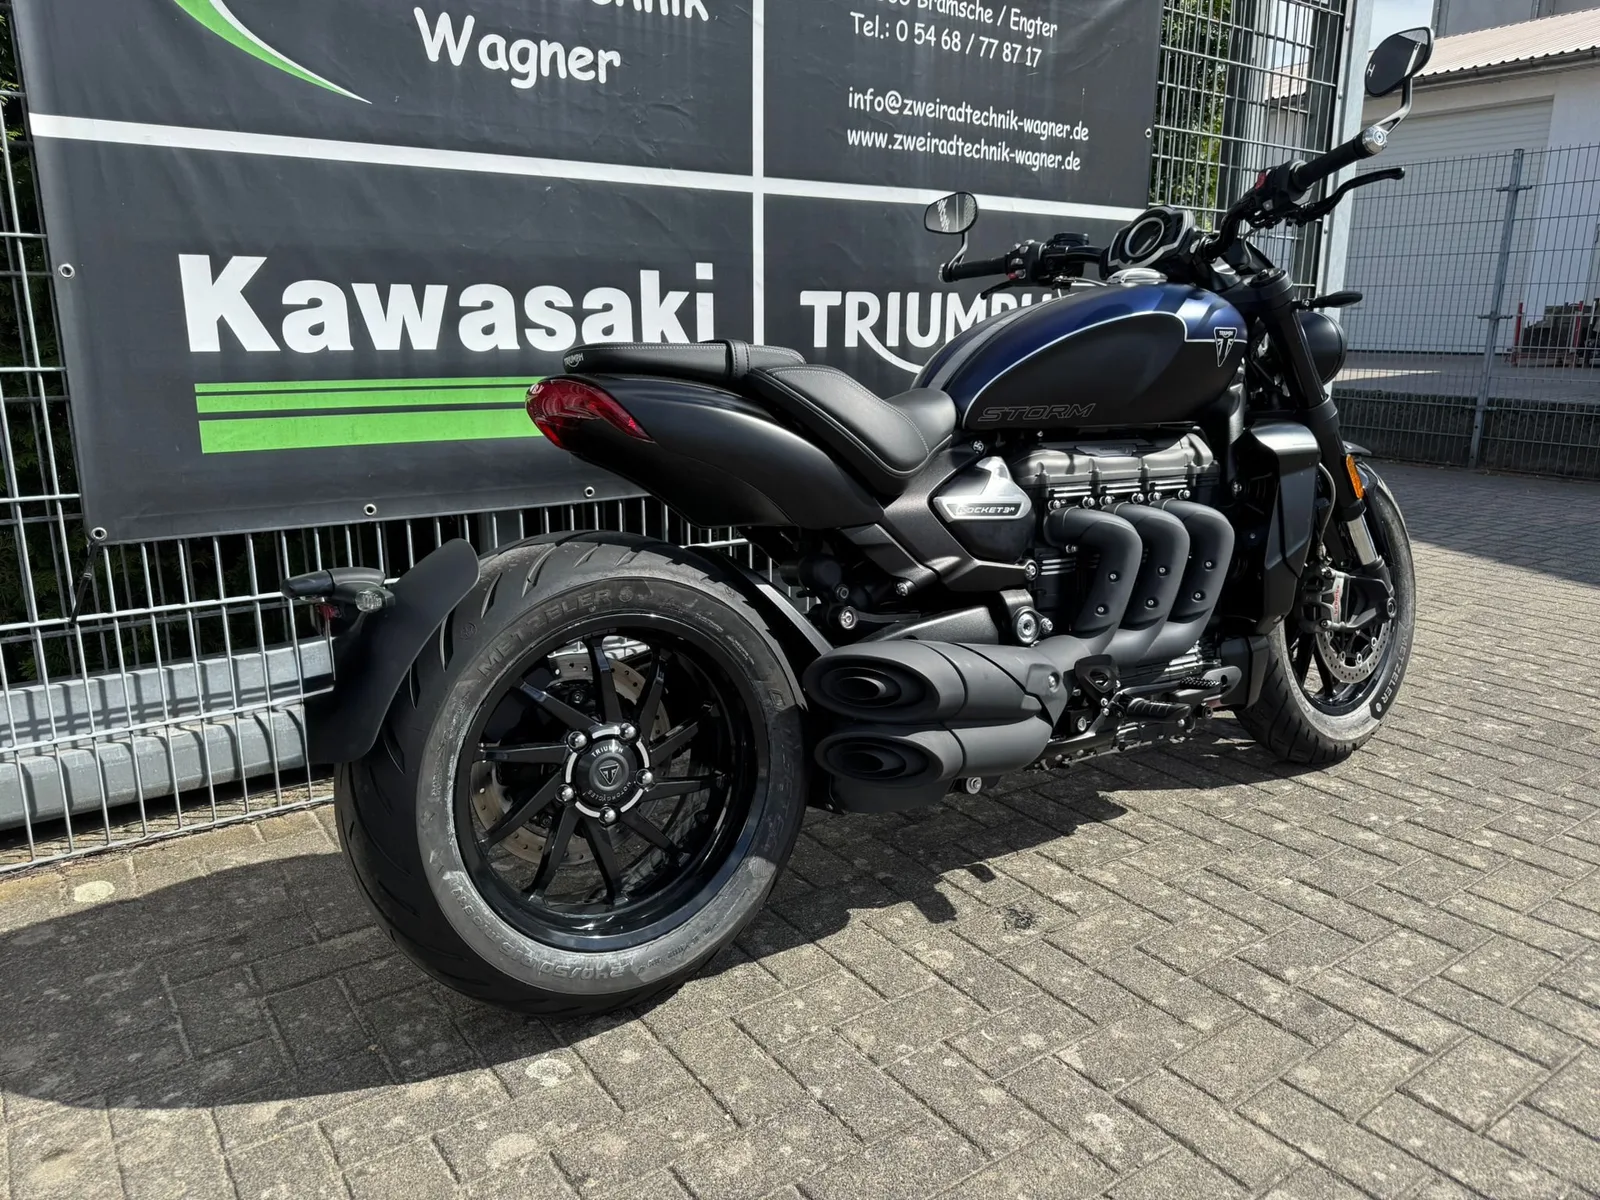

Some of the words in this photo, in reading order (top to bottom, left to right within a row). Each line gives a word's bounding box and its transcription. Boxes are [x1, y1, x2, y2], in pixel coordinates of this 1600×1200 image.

[413, 7, 621, 89] Wagner
[850, 12, 890, 39] Tel.:
[895, 20, 909, 42] 0
[913, 23, 937, 47] 54
[941, 28, 961, 52] 68
[965, 33, 975, 55] /
[978, 36, 999, 60] 77
[1002, 42, 1022, 64] 87
[1025, 46, 1043, 68] 17
[996, 5, 1007, 27] /
[1009, 8, 1058, 39] Engter
[848, 87, 1089, 142] info@zweiradtechnik-wagner.de
[847, 129, 1081, 171] www.zweiradtechnik-wagner.de
[178, 253, 714, 354] Kawasaki
[799, 290, 1053, 374] TRIUM
[978, 403, 1096, 422] STORM
[1380, 633, 1410, 704] METZELER
[591, 745, 624, 757] TRIUMPH
